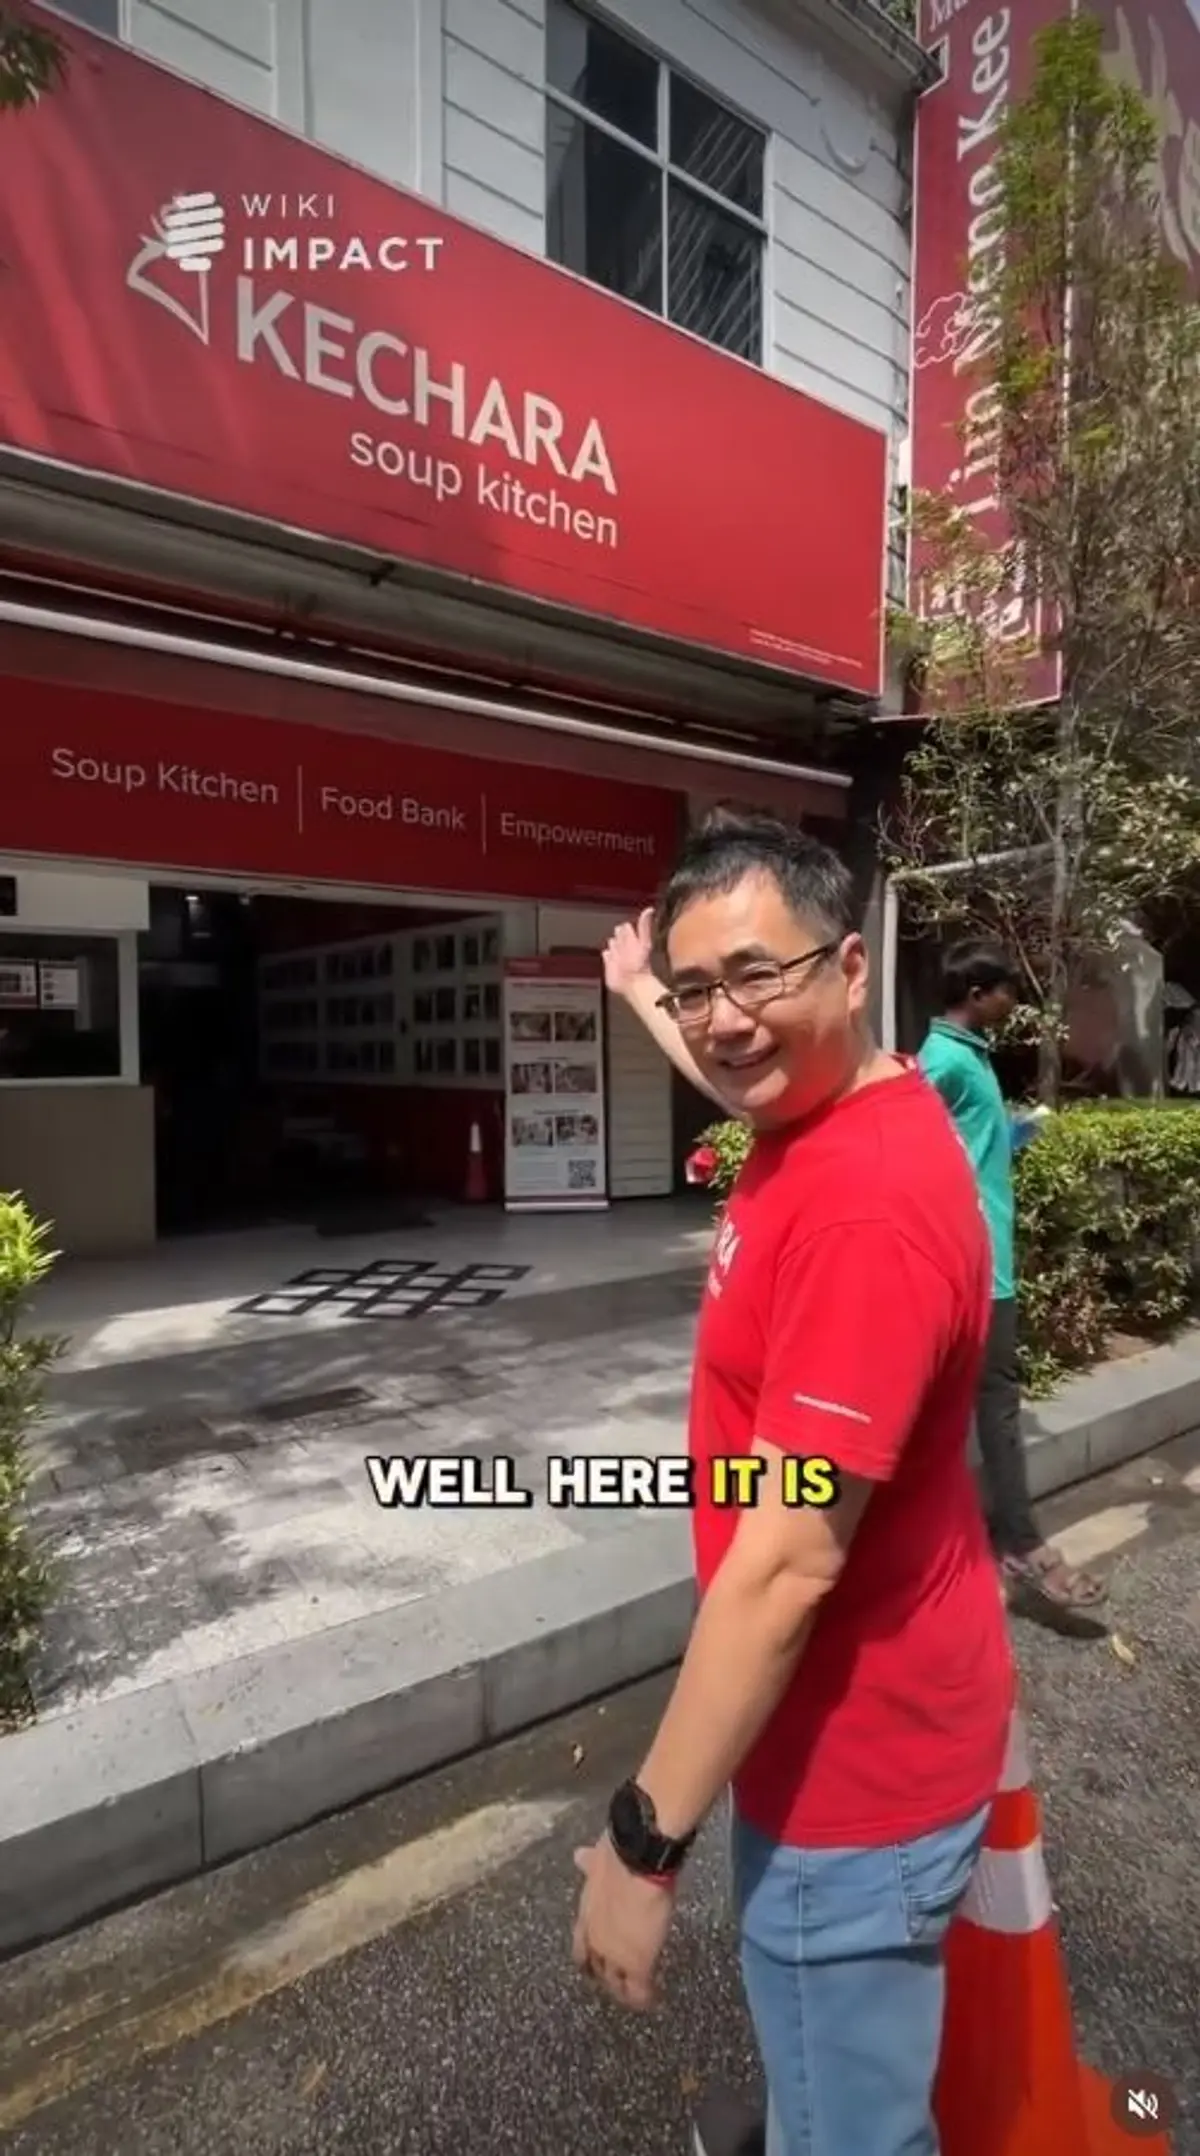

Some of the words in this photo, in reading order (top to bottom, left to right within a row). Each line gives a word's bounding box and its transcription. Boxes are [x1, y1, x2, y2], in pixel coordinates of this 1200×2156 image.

[957, 7, 1011, 162] Kee
[236, 276, 617, 495] KECHARA
[350, 431, 462, 499] soup
[478, 464, 618, 548] kitchen
[51, 747, 146, 790] Soup
[158, 759, 279, 804] Kitchen
[321, 786, 393, 821] Food
[402, 797, 466, 830] Bank
[501, 812, 655, 856] Empowerment
